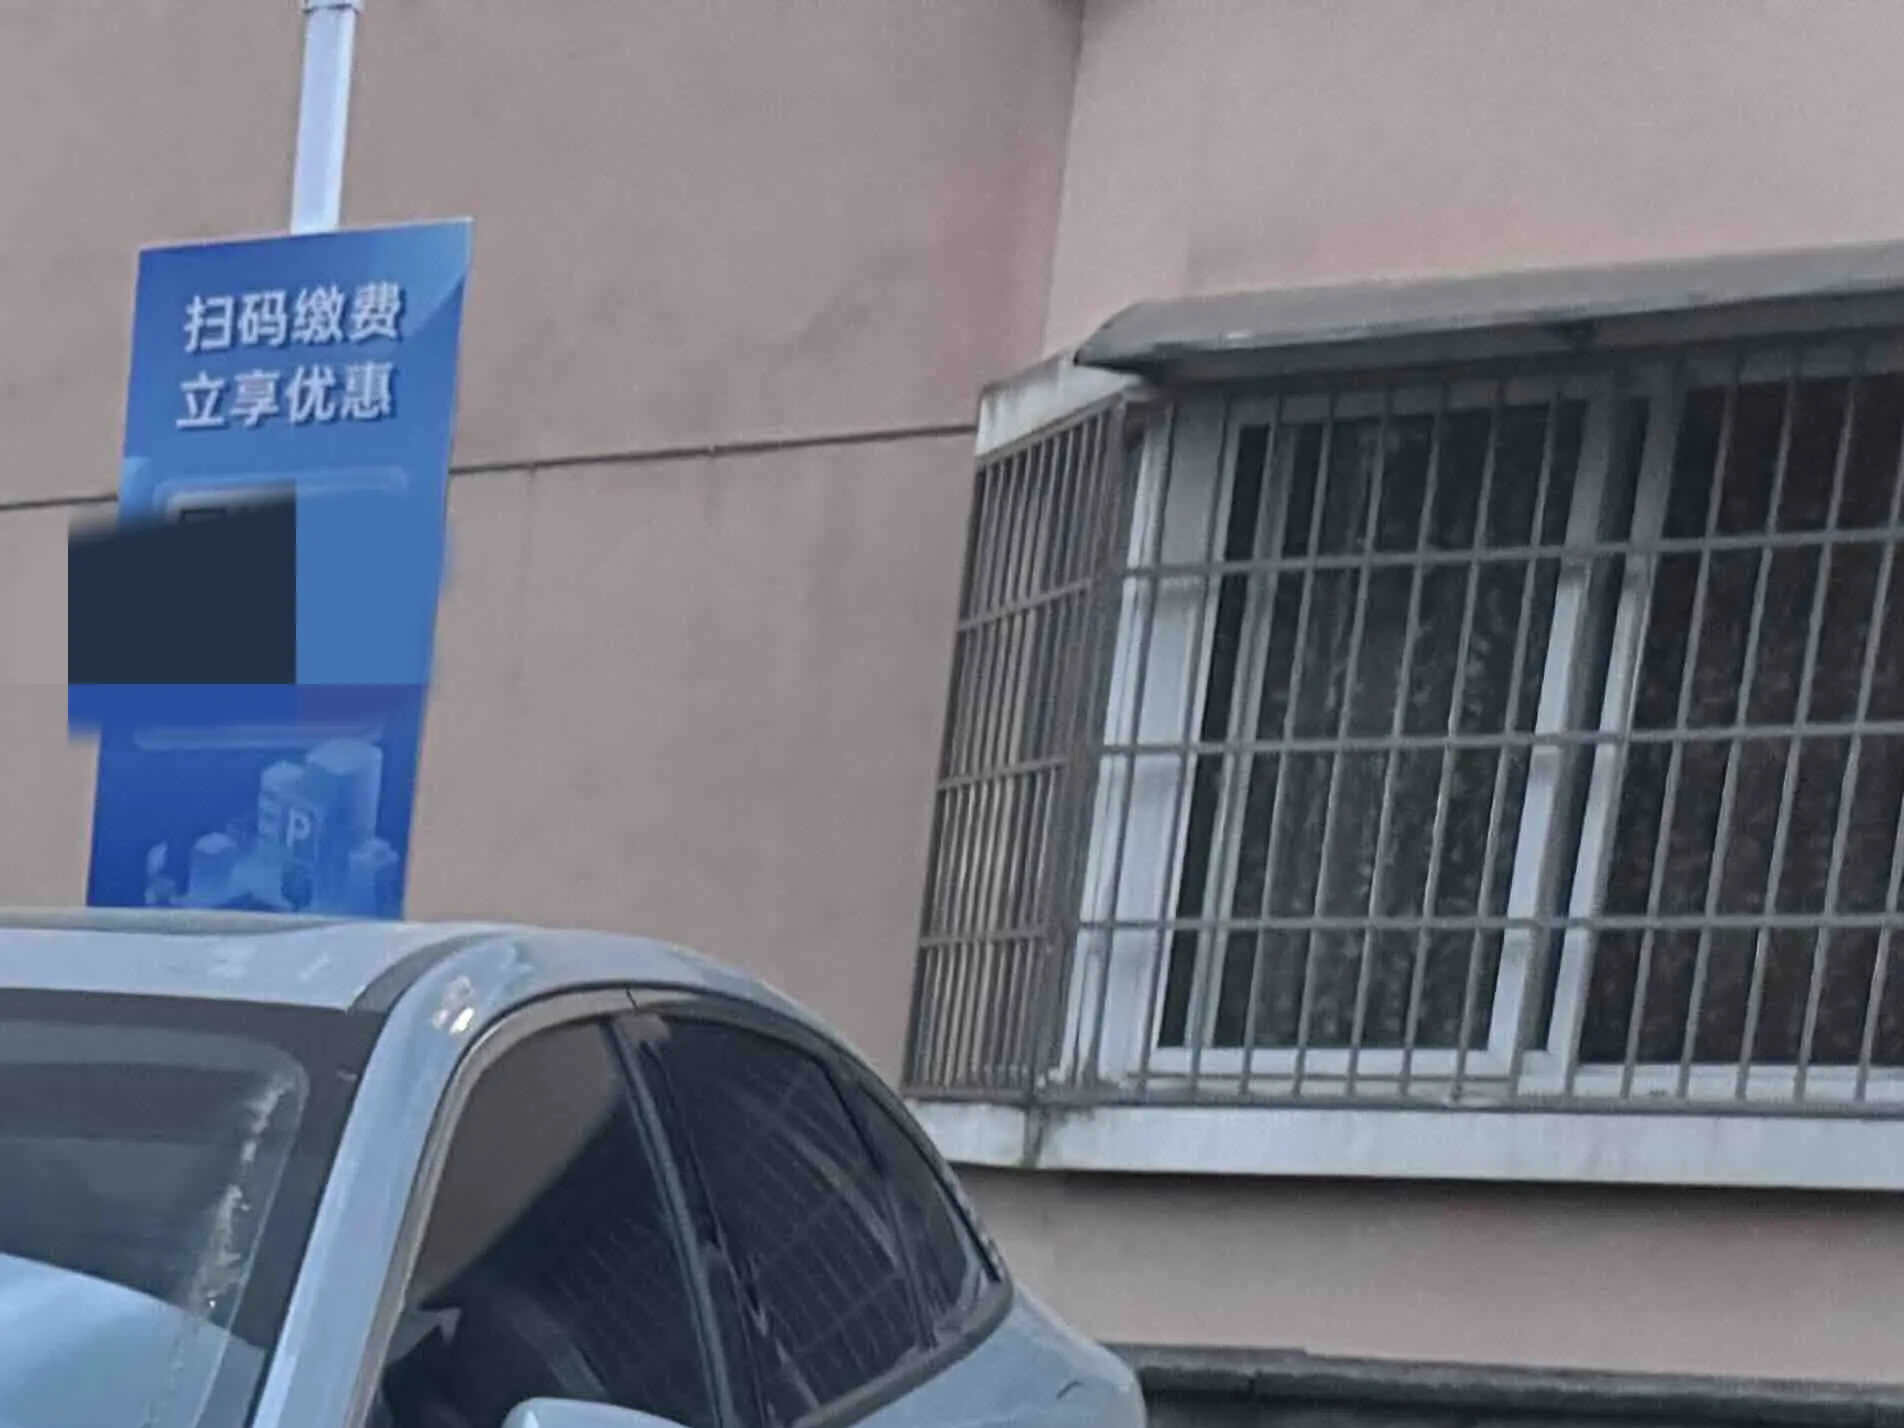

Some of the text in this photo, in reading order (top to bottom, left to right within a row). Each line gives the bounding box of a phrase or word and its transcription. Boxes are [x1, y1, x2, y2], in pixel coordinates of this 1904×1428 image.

[184, 280, 401, 352] 扫码缴费
[176, 361, 393, 428] 立享优惠
